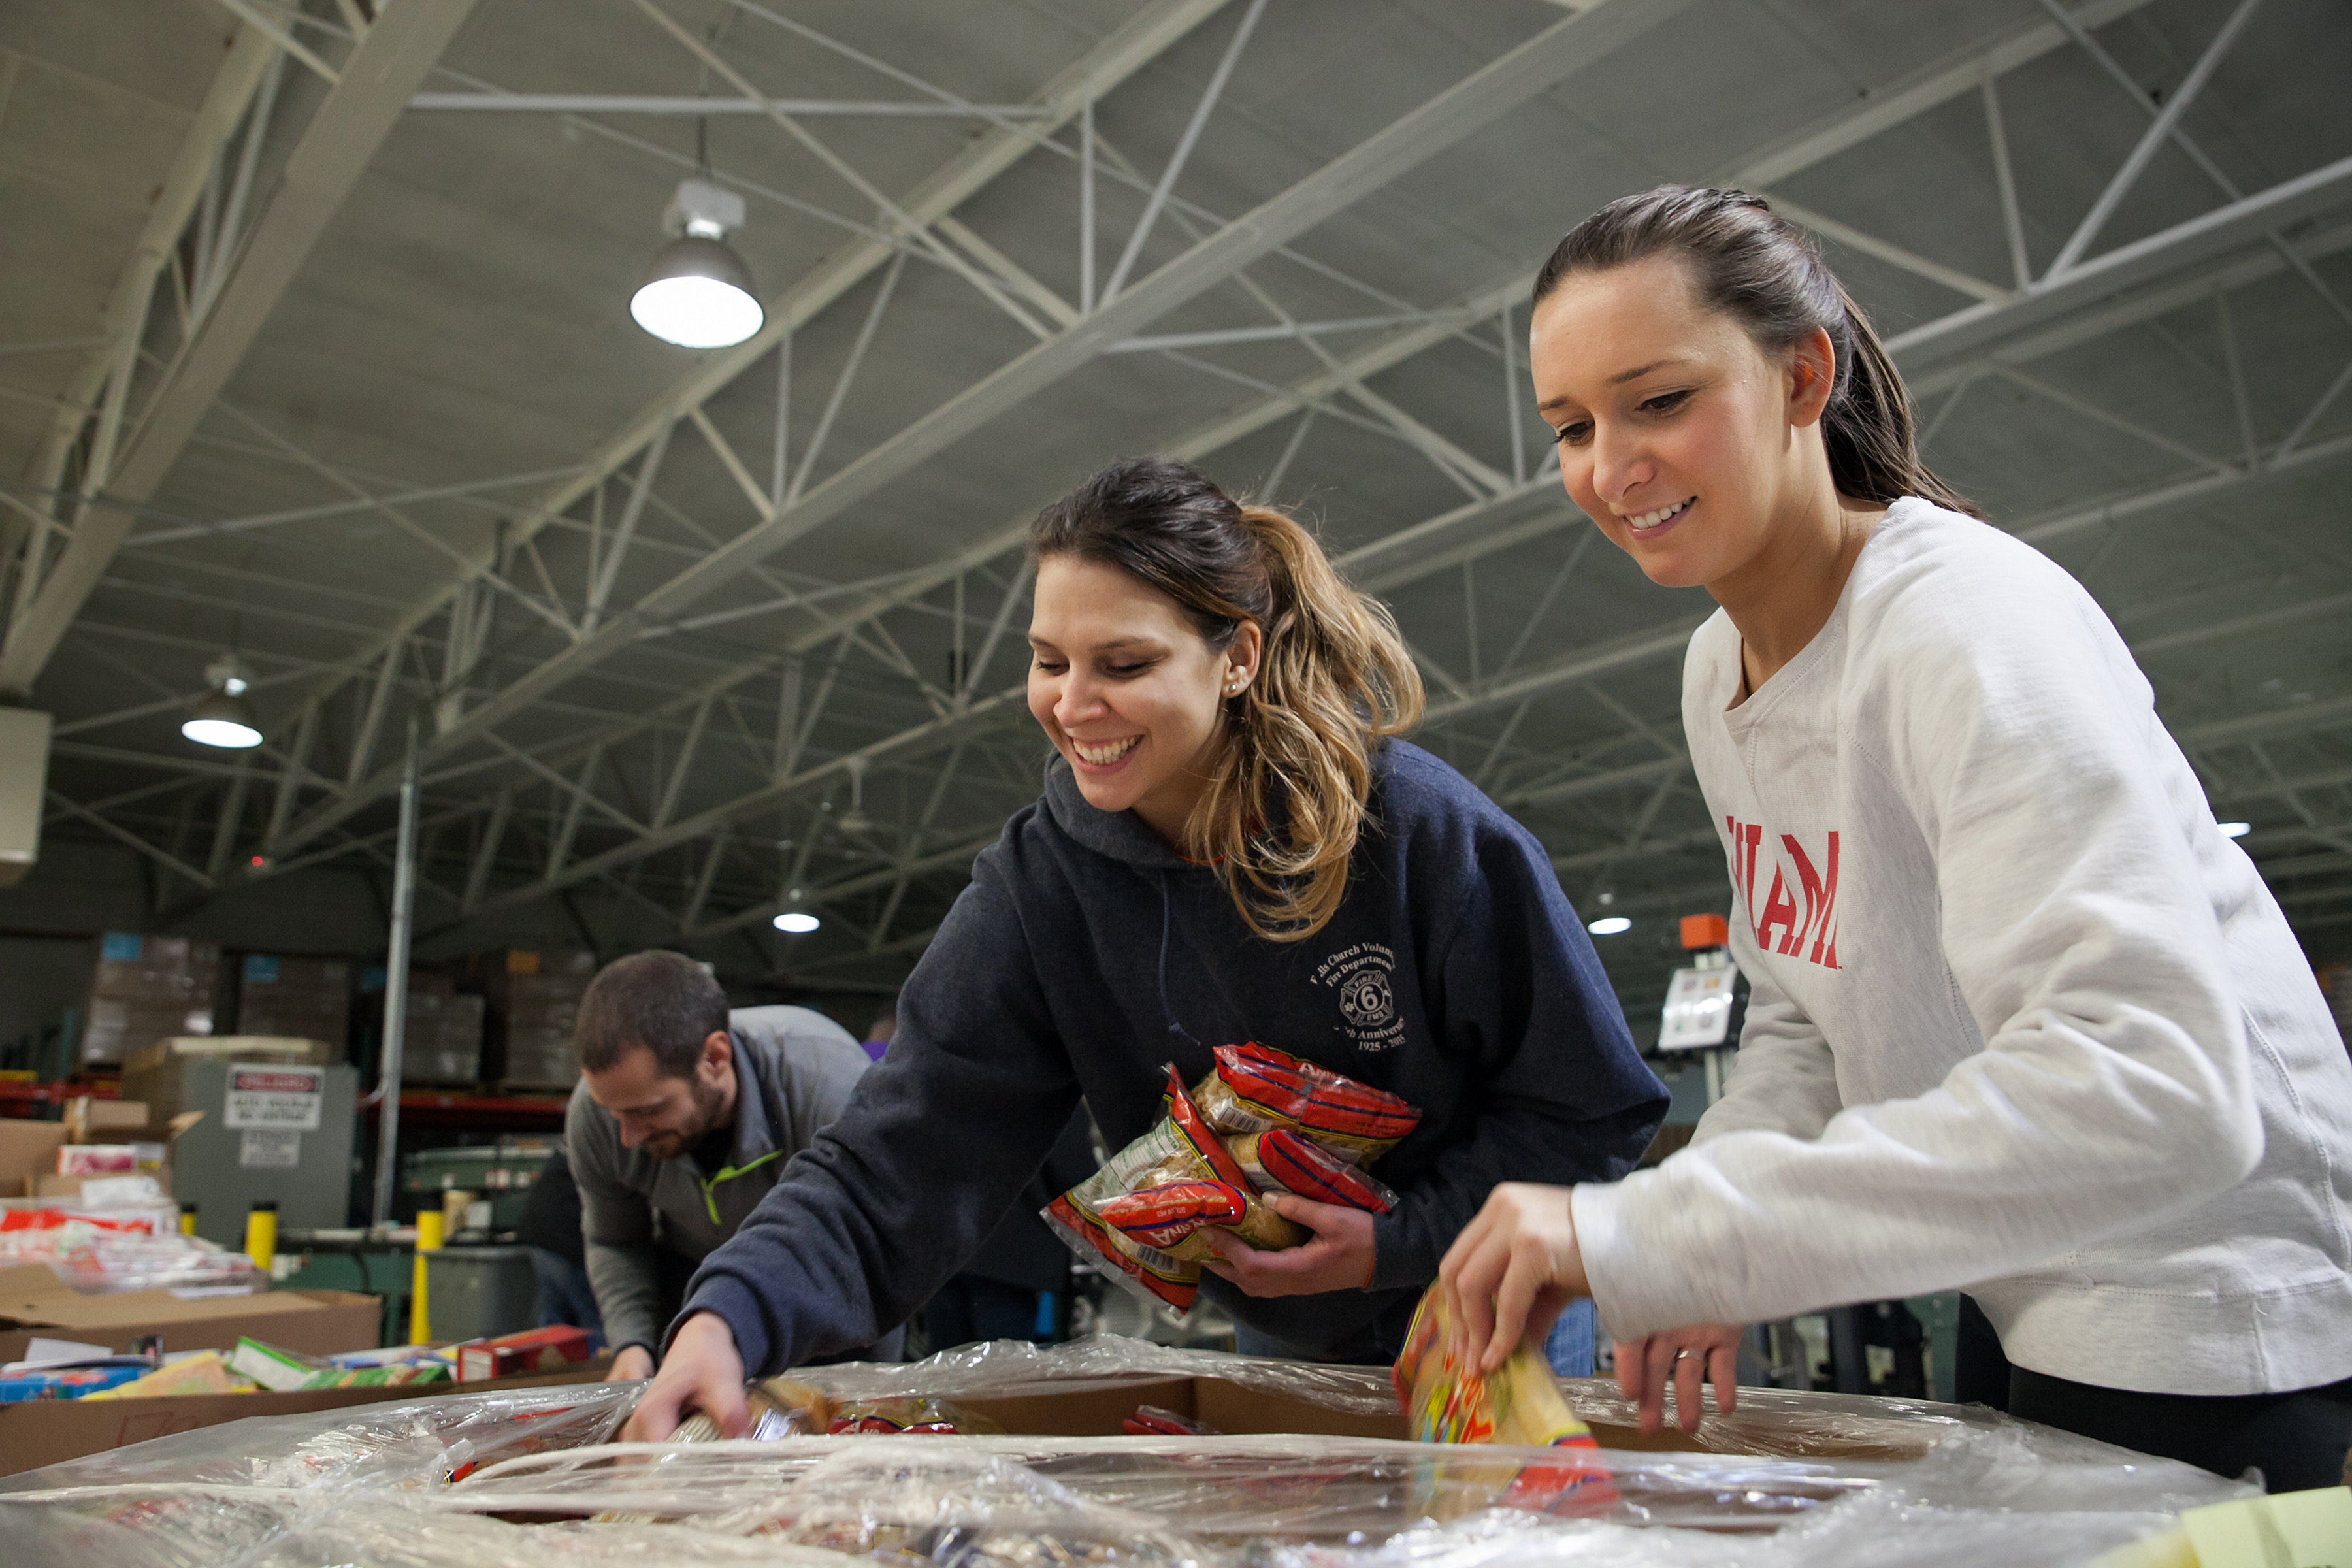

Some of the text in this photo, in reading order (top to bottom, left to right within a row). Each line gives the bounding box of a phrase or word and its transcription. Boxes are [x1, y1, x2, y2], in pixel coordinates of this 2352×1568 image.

[1309, 942, 1396, 985] Flls Church Volunt
[1325, 971, 1342, 987] Fire
[1354, 975, 1373, 987] FIRE
[1360, 986, 1379, 1010] 6
[1367, 1011, 1384, 1021] EMS
[1358, 1041, 1381, 1051] 1925
